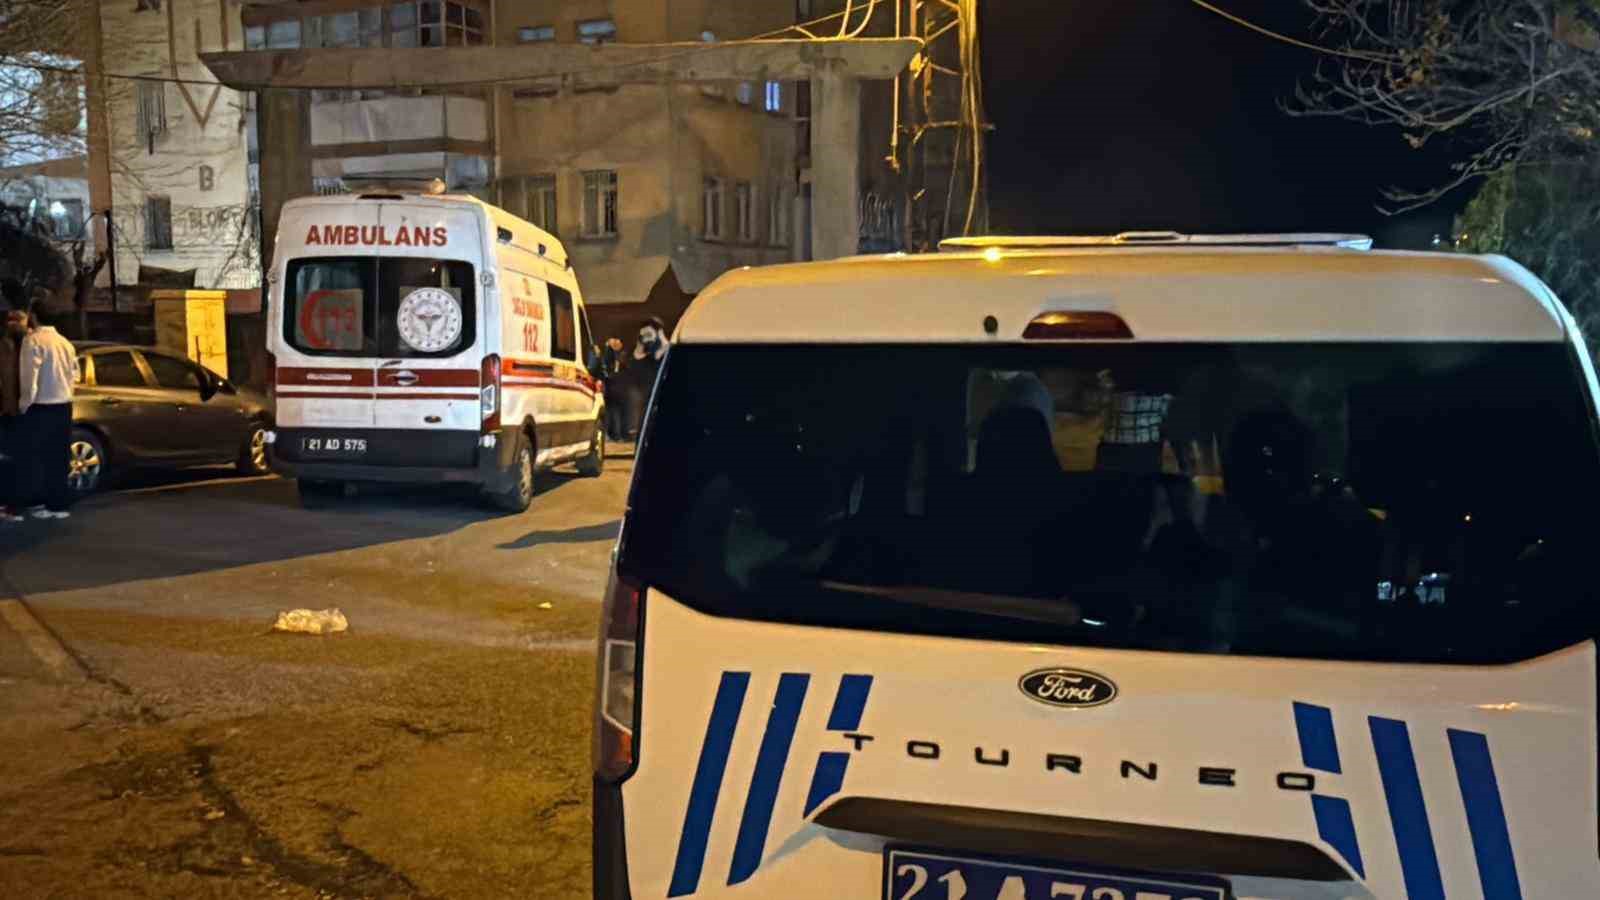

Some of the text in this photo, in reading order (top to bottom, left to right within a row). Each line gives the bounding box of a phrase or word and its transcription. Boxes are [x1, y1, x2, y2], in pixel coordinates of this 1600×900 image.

[199, 165, 214, 191] B
[305, 224, 448, 247] AMBULANS
[309, 439, 367, 450] 21 AD 575
[1038, 674, 1097, 701] Ford
[843, 732, 1316, 791] TOURNEO
